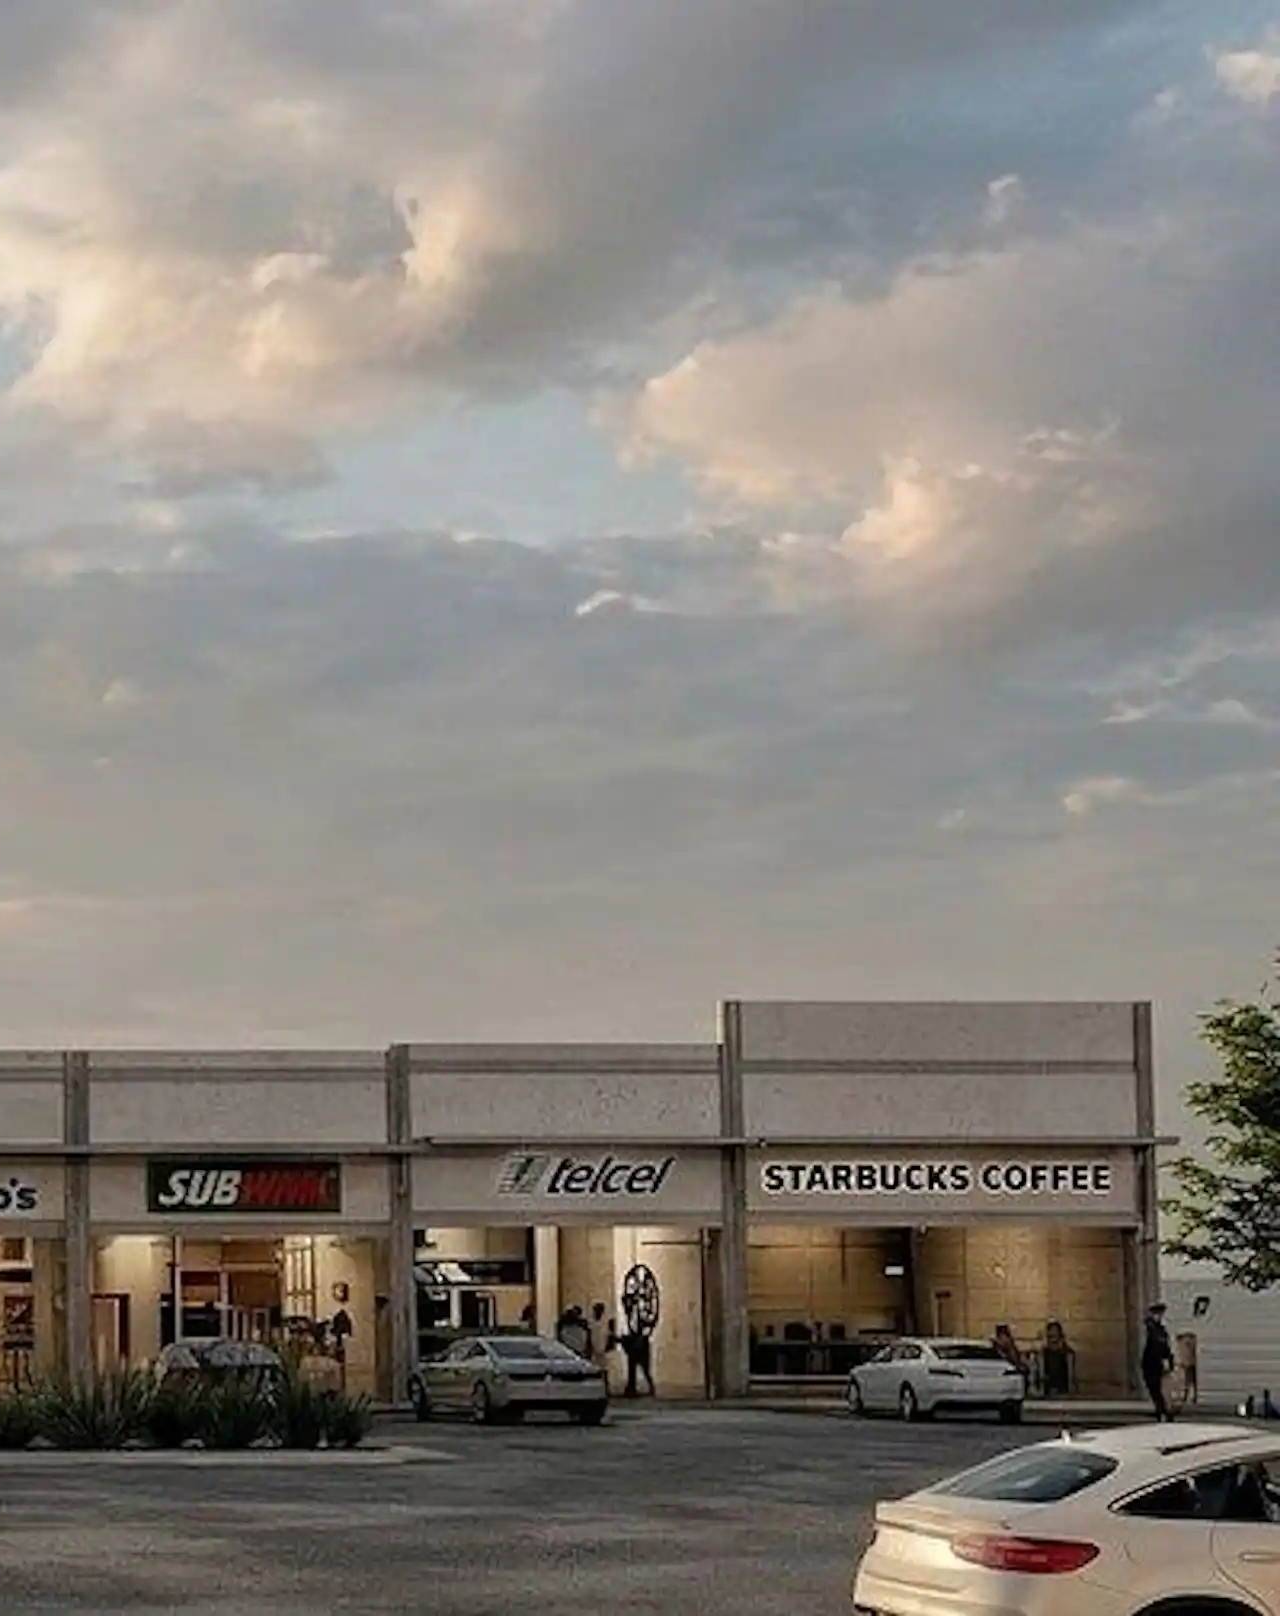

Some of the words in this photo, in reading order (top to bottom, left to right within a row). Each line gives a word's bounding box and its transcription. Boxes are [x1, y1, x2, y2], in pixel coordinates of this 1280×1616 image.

[547, 1156, 676, 1193] telcel
[764, 1164, 971, 1190] STARBUCKS
[981, 1164, 1111, 1190] COFFEE
